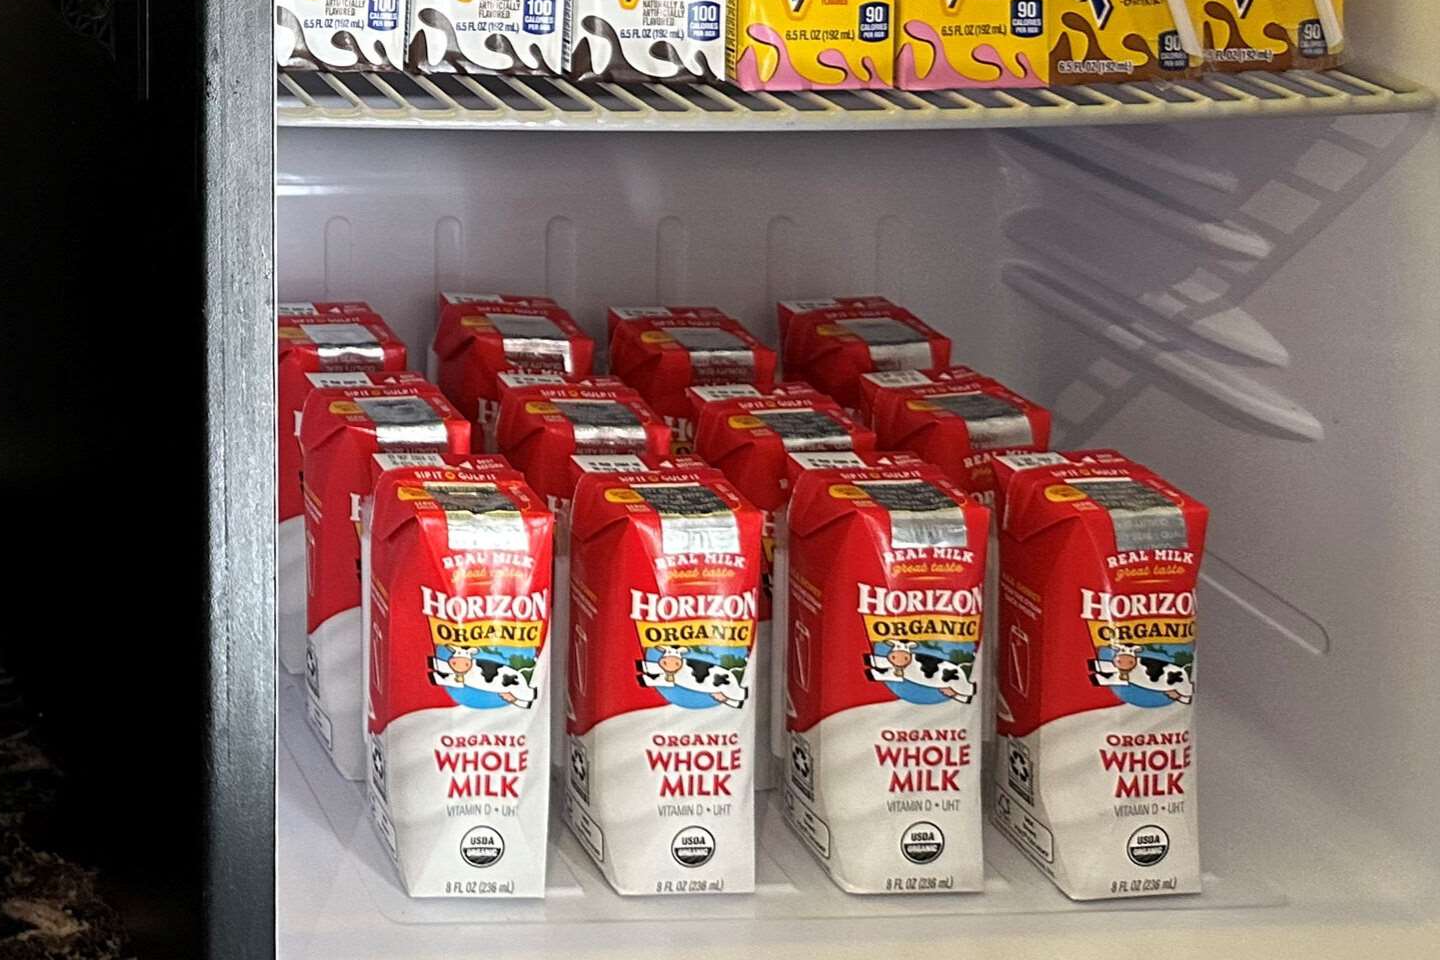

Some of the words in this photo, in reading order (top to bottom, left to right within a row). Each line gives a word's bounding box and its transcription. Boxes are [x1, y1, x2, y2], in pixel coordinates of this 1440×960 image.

[527, 0, 552, 15] 100
[691, 5, 716, 21] 100
[866, 6, 884, 22] 90
[1019, 1, 1037, 17] 90
[883, 548, 927, 563] REAL
[1107, 552, 1149, 568] REAL
[1154, 550, 1194, 565] MILK
[421, 585, 548, 621] HORIZON
[630, 588, 756, 621] HORIZON
[857, 582, 982, 615] HORIZON
[437, 623, 539, 642] ORGANIC
[645, 624, 748, 642] ORGANIC
[873, 619, 977, 637] ORGANIC
[441, 734, 526, 747] ORGANIC
[653, 733, 738, 747] ORGANIC
[881, 729, 967, 742] ORGANIC
[1106, 731, 1190, 747] ORGANIC
[434, 749, 529, 773] WHOLE
[646, 748, 741, 772] WHOLE
[874, 744, 971, 768] WHOLE
[1099, 745, 1191, 773] WHOLE
[448, 775, 520, 799] MILK
[660, 774, 732, 797] MILK
[888, 769, 960, 793] MILK
[1115, 772, 1184, 798] MILK
[446, 805, 481, 817] VITAMIN
[658, 805, 694, 816] VITAMIN
[887, 800, 923, 812] VITAMIN
[1114, 803, 1150, 817] VITAMIN
